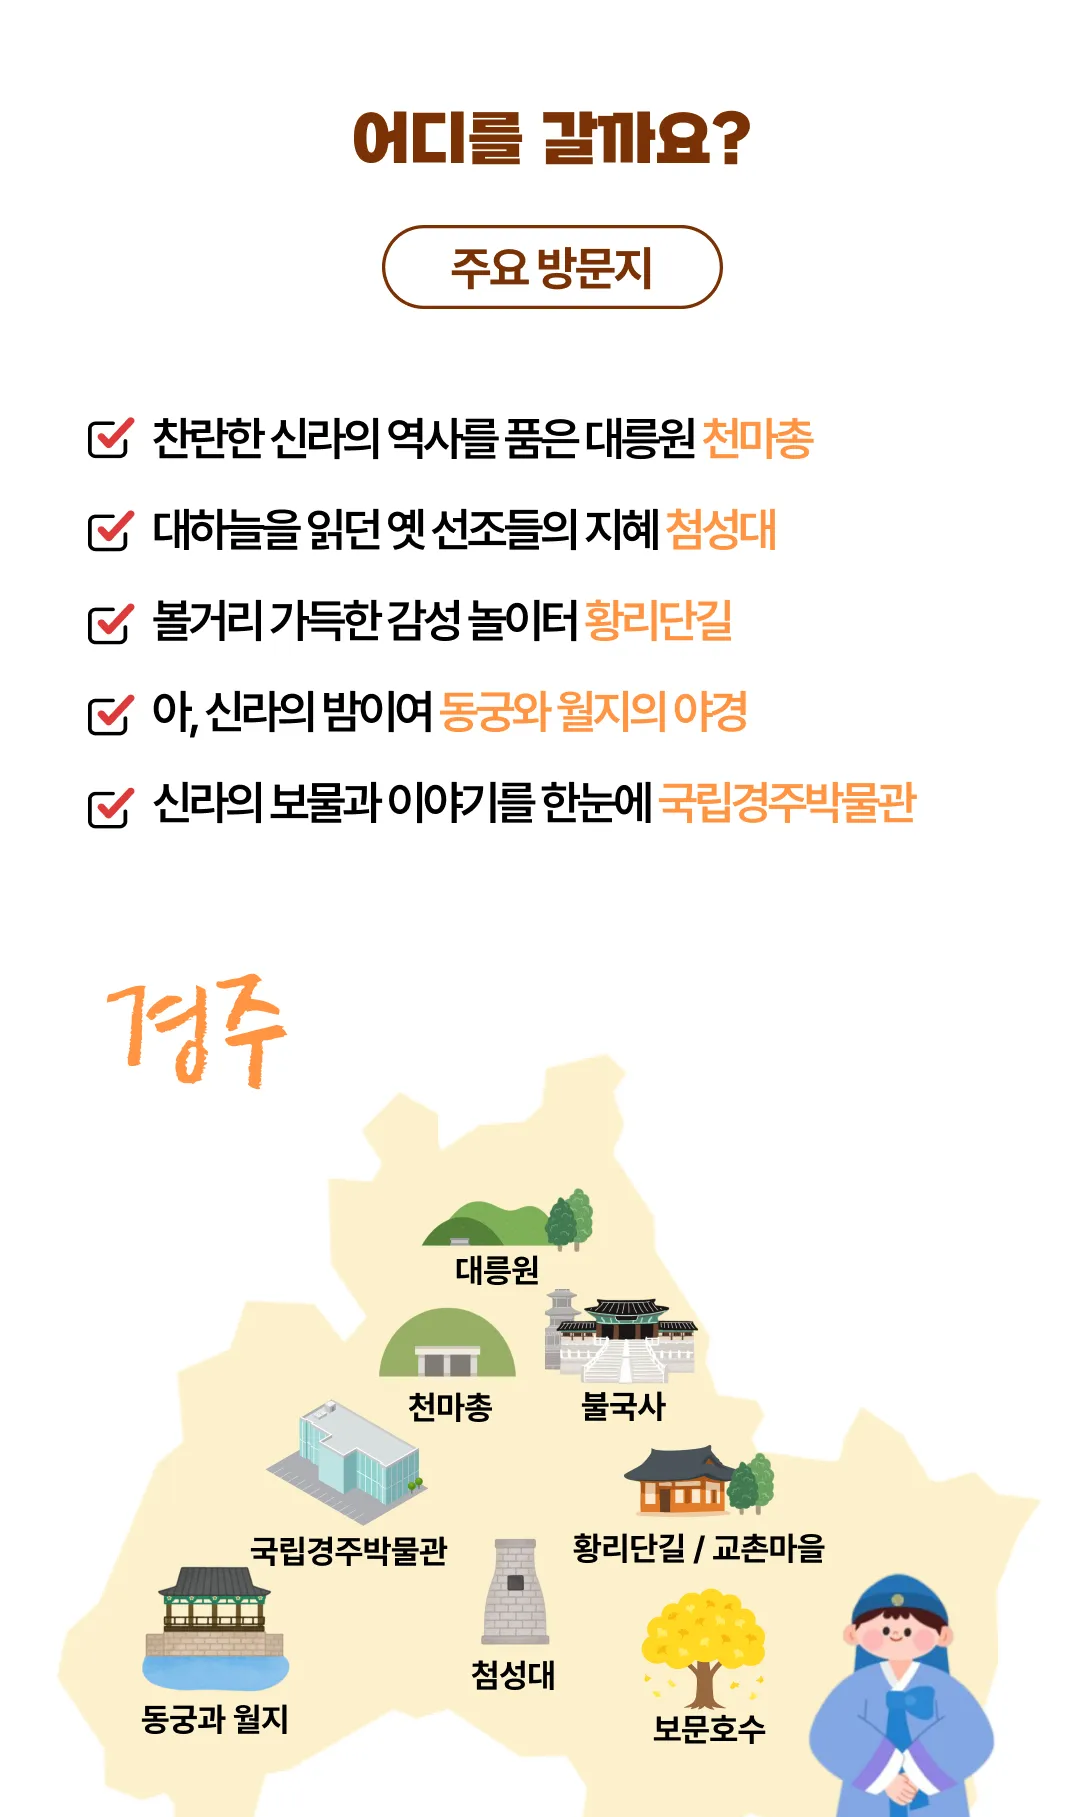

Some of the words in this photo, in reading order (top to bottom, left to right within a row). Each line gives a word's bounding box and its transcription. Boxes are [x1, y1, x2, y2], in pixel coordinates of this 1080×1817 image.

[354, 111, 522, 165] 어디를
[543, 110, 750, 165] 갈까요?
[451, 249, 529, 290] 주요
[538, 247, 650, 290] 방문지
[153, 418, 265, 459] 찬란한
[271, 418, 378, 459] 신라의
[388, 418, 499, 459] 역사를
[505, 419, 580, 459] 품은
[587, 418, 695, 459] 대릉원
[703, 418, 814, 459] 천마총
[154, 509, 301, 550] 대하늘을
[308, 509, 380, 550] 읽던
[388, 509, 425, 550] 옛
[432, 509, 576, 550] 선조들의
[585, 509, 658, 550] 지혜
[666, 508, 775, 550] 첨성대
[153, 600, 261, 641] 볼거리
[270, 600, 382, 641] 가득한
[388, 600, 459, 641] 감성
[468, 600, 577, 641] 놀이터
[585, 599, 731, 641] 황리단길
[153, 691, 198, 738] 아,
[206, 691, 313, 732] 신라의
[324, 691, 431, 732] 밤이여
[440, 690, 552, 732] 동궁와
[557, 691, 665, 732] 월지의
[675, 690, 746, 732] 야경
[153, 782, 261, 823] 신라의
[270, 782, 382, 823] 보물과
[389, 782, 536, 823] 이야기를
[541, 782, 651, 823] 한눈에
[659, 782, 917, 823] 국립경주박물관
[107, 974, 287, 1089] 경주
[457, 1256, 538, 1285] 대릉원
[409, 1393, 492, 1422] 천마총
[582, 1392, 666, 1421] 불국사
[250, 1536, 448, 1567] 국립경주박물관
[574, 1533, 684, 1563] 황리단길
[694, 1535, 705, 1564] /
[713, 1534, 825, 1563] 교촌마을
[472, 1660, 554, 1690] 첨성대
[142, 1705, 226, 1734] 동궁과
[234, 1705, 287, 1734] 월지
[654, 1715, 765, 1744] 보문호수
